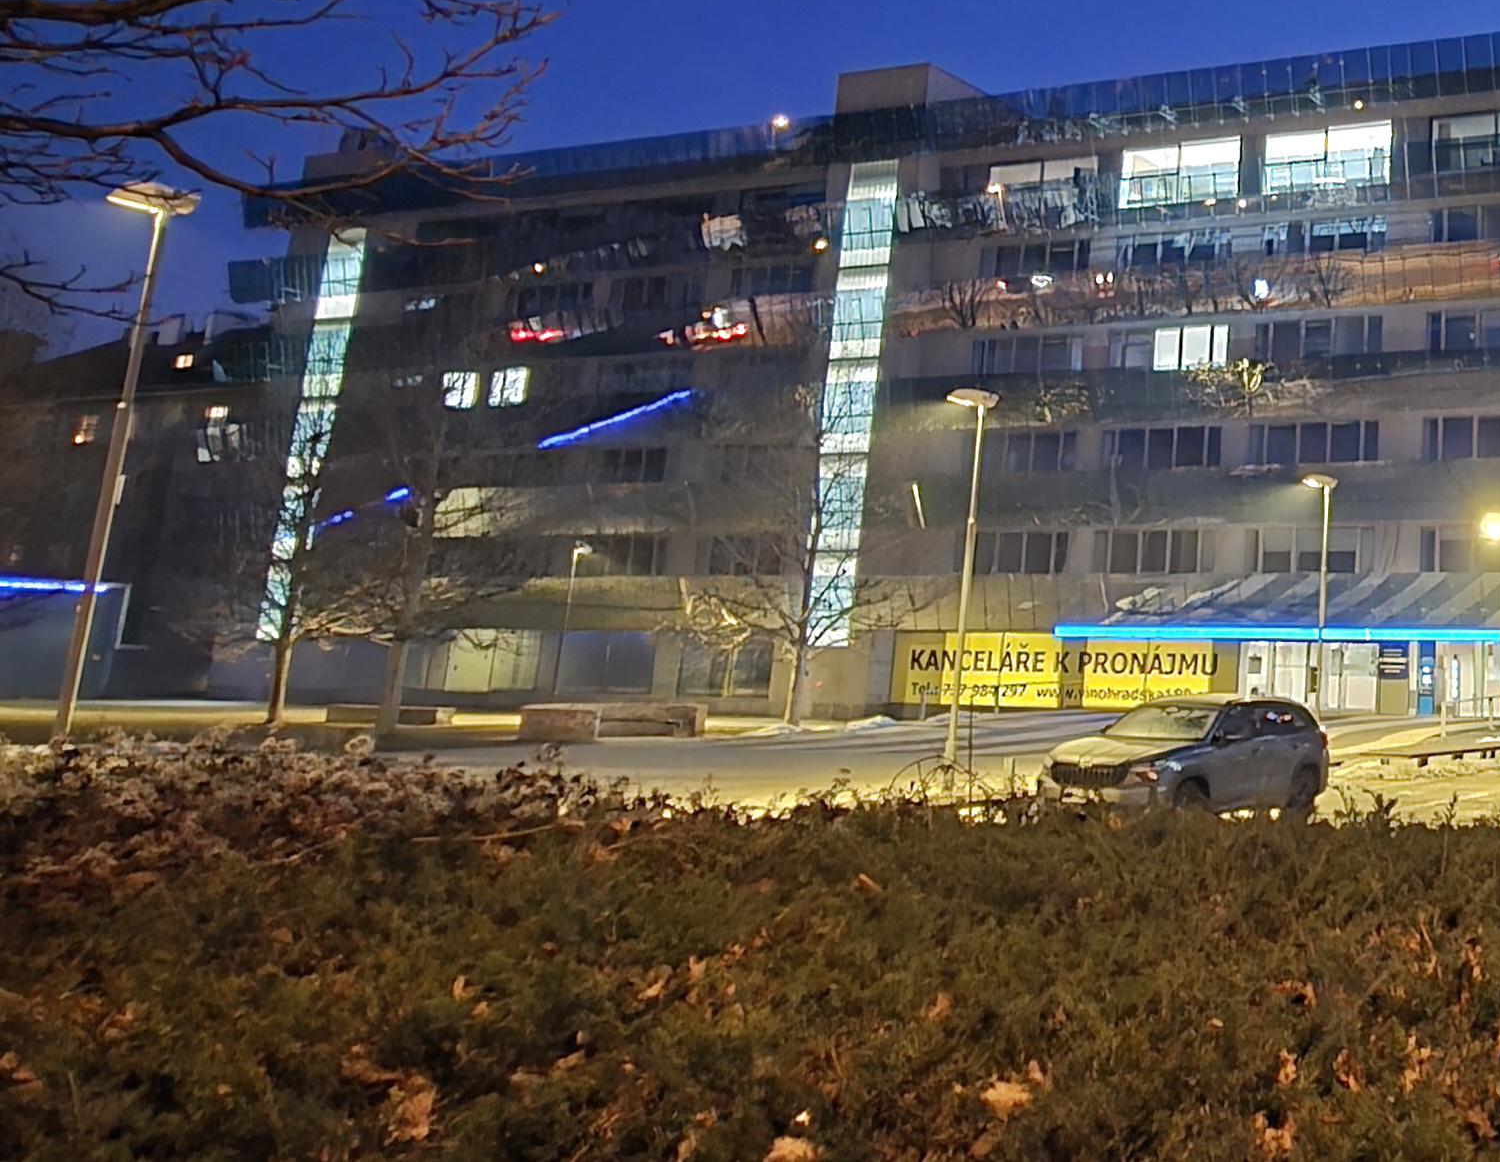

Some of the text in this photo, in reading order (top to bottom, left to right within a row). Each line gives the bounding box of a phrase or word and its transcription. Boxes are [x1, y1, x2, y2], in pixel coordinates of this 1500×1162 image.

[910, 642, 1219, 676] KANCELÁŘE K PRONÁJMU
[943, 683, 967, 697] 77
